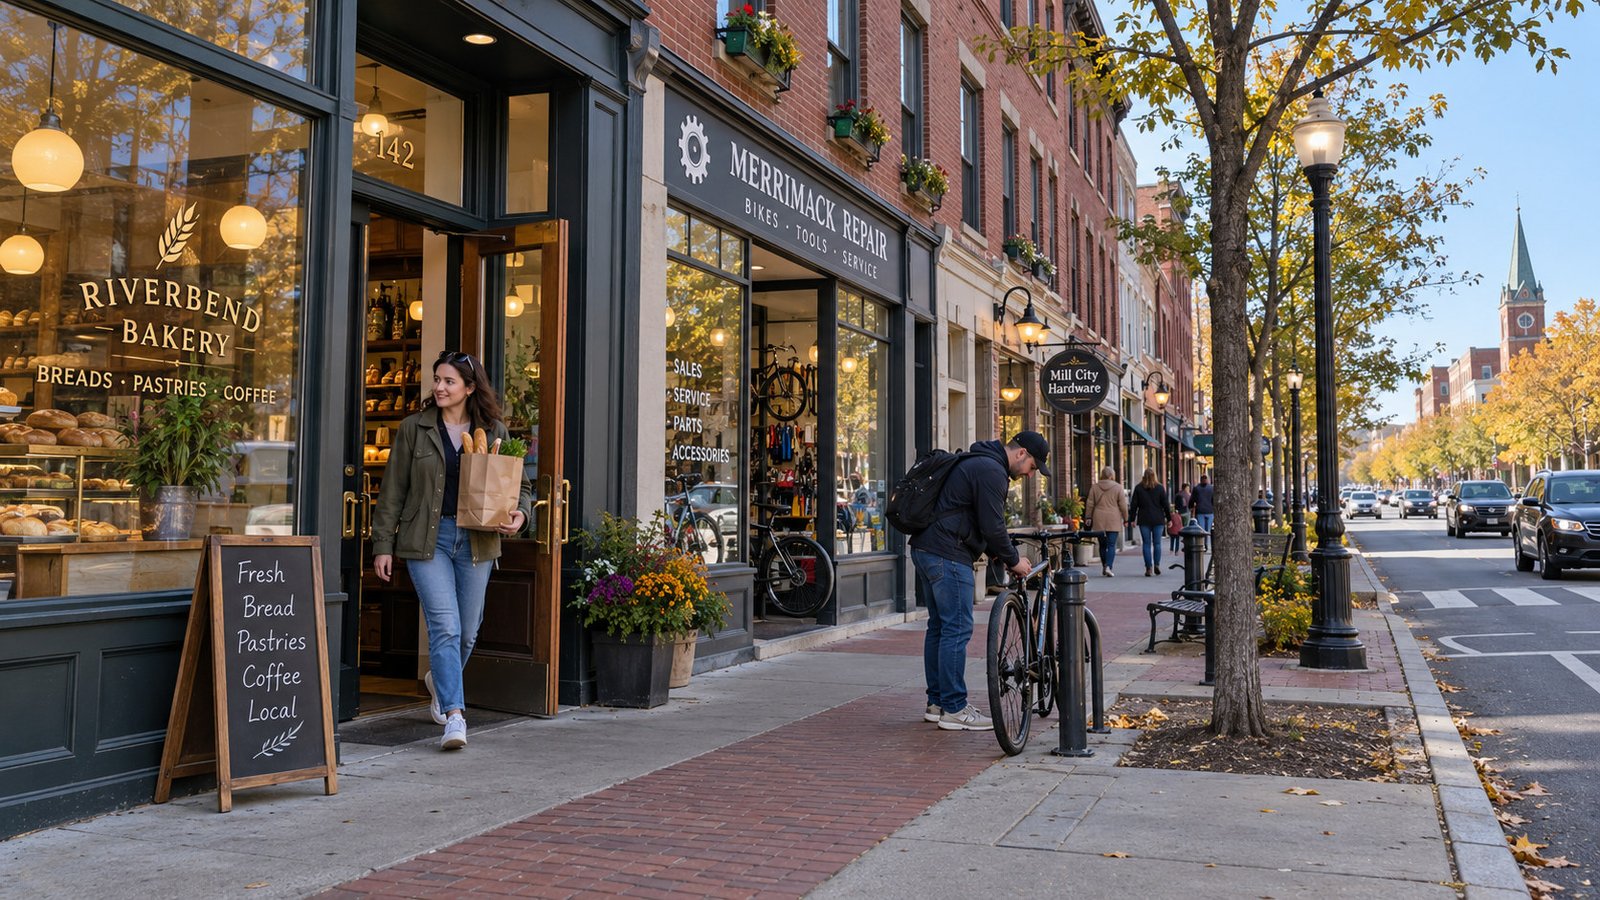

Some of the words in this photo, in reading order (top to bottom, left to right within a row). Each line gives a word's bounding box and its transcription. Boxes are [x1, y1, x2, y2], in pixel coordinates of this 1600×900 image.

[376, 130, 414, 170] 142
[730, 141, 836, 232] MERRIMACK
[842, 208, 888, 261] REPAIR
[745, 197, 778, 228] BIKES
[796, 224, 827, 254] TOOLS
[842, 250, 877, 279] SERVICE
[79, 278, 261, 333] RIVERBEND
[122, 318, 230, 357] BAKERY
[673, 358, 702, 379] SALES
[1050, 369, 1072, 381] Mill
[1075, 369, 1098, 382] City
[36, 364, 112, 389] BREADS
[133, 374, 207, 398] PASTRIES
[223, 385, 277, 405] COFFEE
[673, 387, 711, 407] SERVICE
[1048, 383, 1101, 394] Hardware
[673, 415, 703, 434] PARTS
[672, 444, 730, 463] ACCESSORIES
[238, 560, 285, 584] Fresh
[243, 594, 295, 618] Bread
[237, 629, 306, 654] Pastries
[242, 662, 302, 692] Coffee
[248, 696, 297, 723] Local
